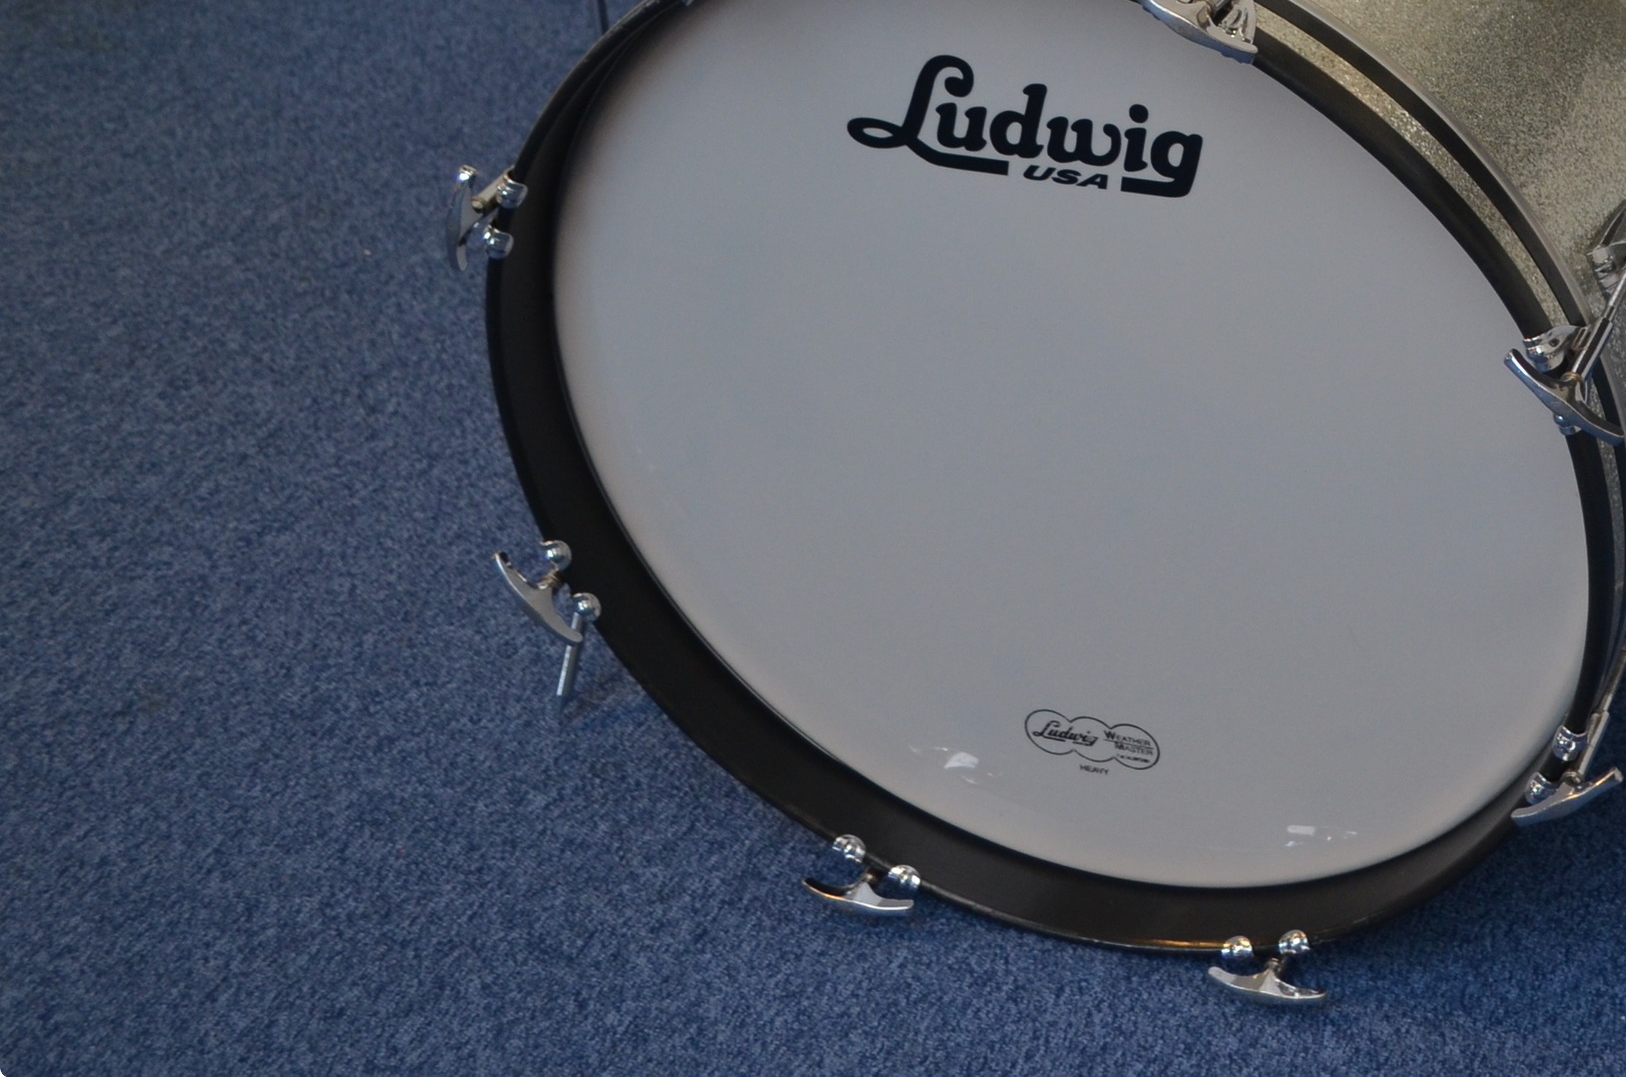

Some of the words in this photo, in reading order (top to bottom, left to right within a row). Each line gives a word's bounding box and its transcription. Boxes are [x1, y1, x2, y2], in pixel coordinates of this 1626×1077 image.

[847, 54, 1204, 198] Ludwig
[1023, 165, 1109, 190] USA
[1032, 720, 1099, 747] Ludwig
[1079, 764, 1109, 774] HEAVY
